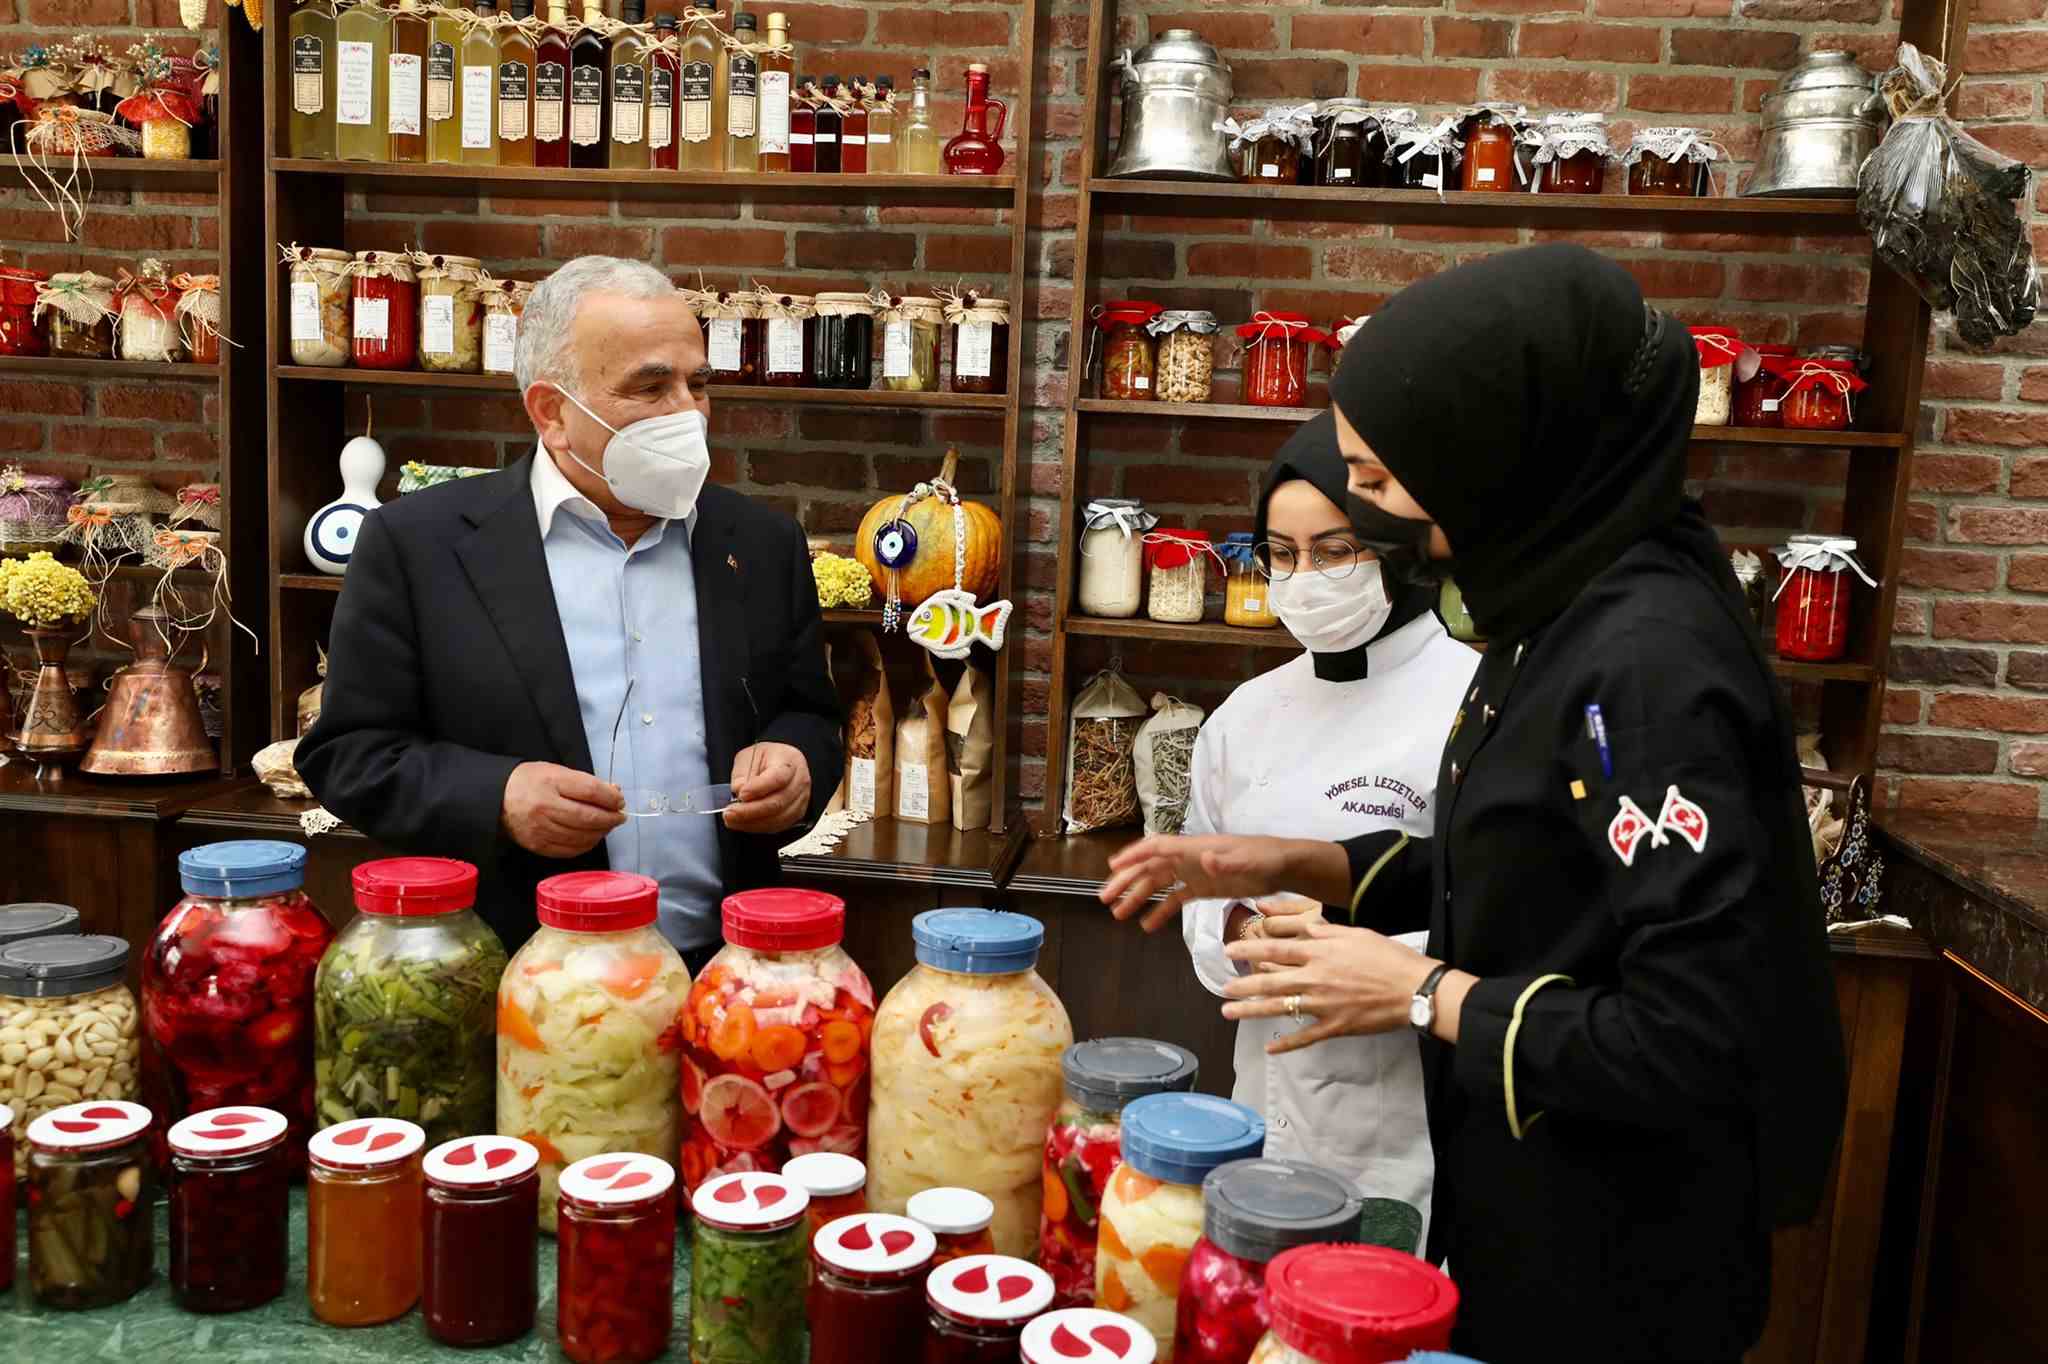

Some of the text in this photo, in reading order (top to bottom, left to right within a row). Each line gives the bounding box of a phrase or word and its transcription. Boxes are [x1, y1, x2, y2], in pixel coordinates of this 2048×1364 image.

[1325, 775, 1427, 812] YÖRESEL LEZZETLER
[1341, 801, 1405, 818] AKADEMİSİ
